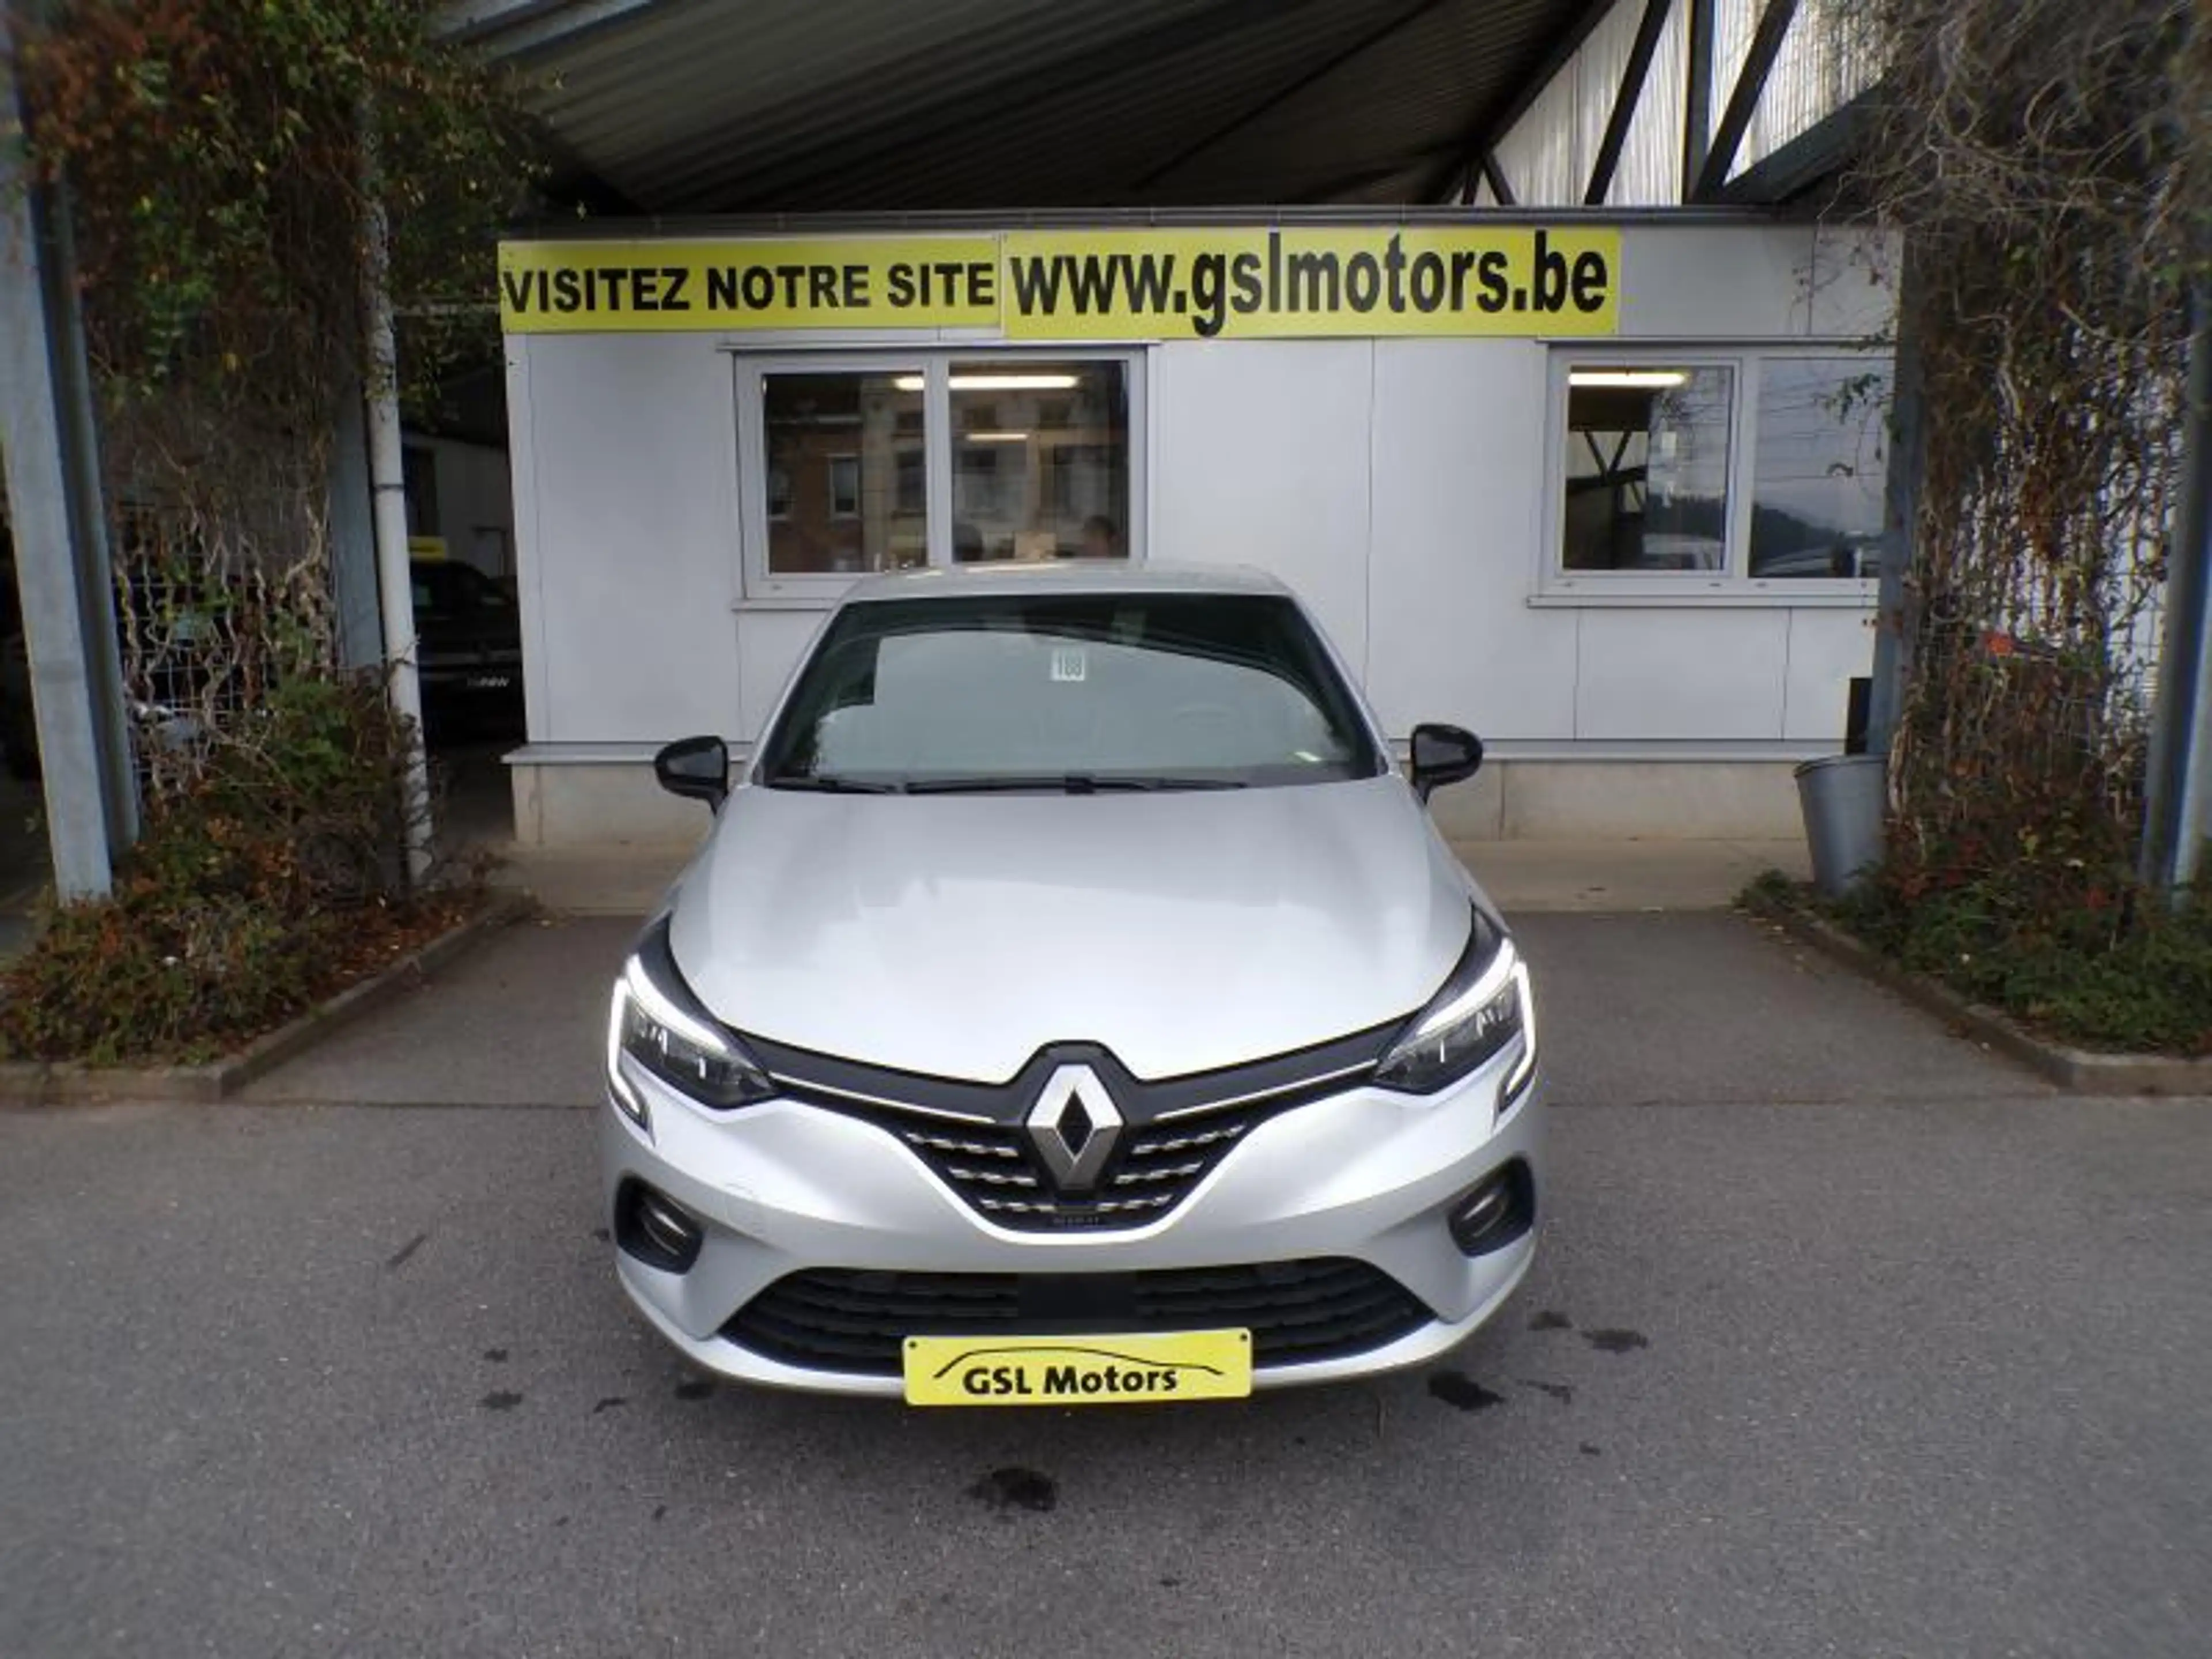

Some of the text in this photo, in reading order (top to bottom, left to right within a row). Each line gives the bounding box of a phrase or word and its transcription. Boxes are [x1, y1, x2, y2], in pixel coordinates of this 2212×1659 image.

[502, 262, 994, 313] VISITEZ NOTRE SITE
[1009, 230, 1608, 339] www.gslmotors.be
[963, 1366, 1177, 1395] GSL Motors
